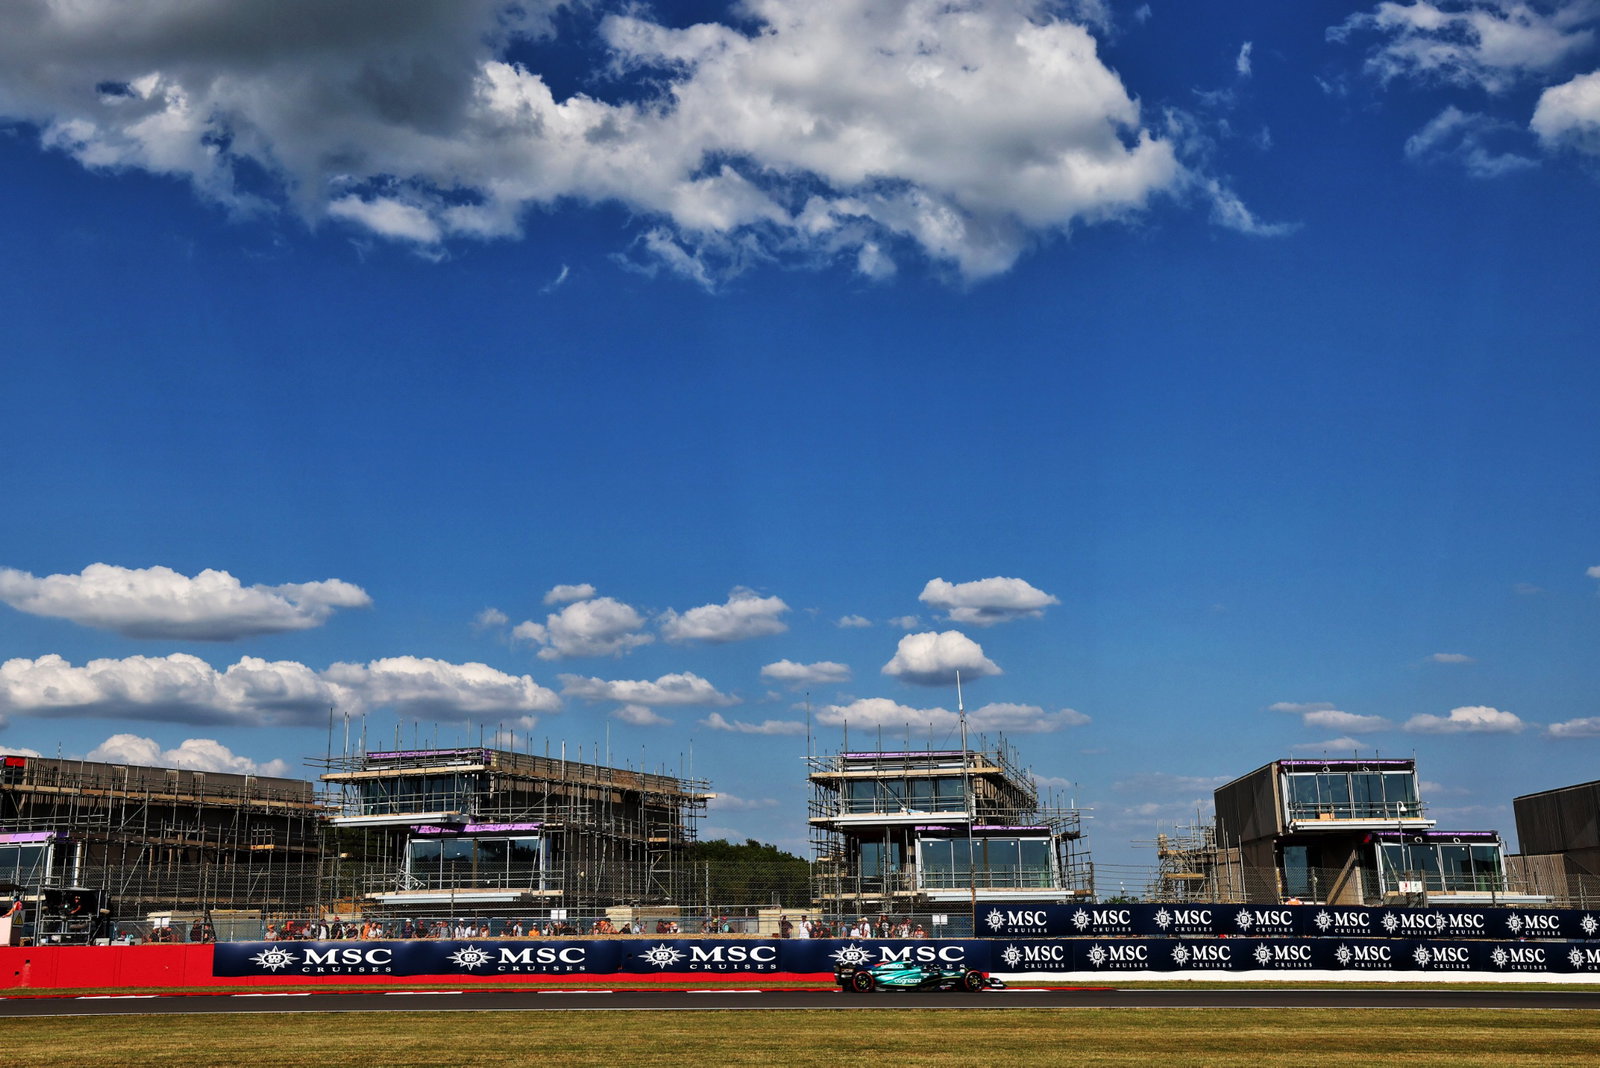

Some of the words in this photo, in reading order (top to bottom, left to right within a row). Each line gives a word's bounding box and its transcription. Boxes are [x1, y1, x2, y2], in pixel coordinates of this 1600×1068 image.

[1007, 911, 1047, 926] MSC
[1092, 910, 1130, 924] MSC
[1174, 910, 1212, 924] MSC
[1255, 911, 1292, 925] MSC
[1334, 912, 1370, 926] MSC
[1401, 914, 1436, 928] MSC
[1449, 914, 1484, 928] MSC
[1525, 915, 1560, 929] MSC
[302, 948, 392, 964] MSC
[498, 948, 586, 964] MSC
[690, 946, 776, 962] MSC
[878, 946, 964, 962] MSC
[1024, 946, 1064, 961] MSC
[1108, 946, 1148, 960] MSC
[1192, 946, 1230, 960] MSC
[1274, 946, 1312, 960] MSC
[1354, 946, 1391, 960] MSC
[1432, 948, 1469, 962] MSC
[1510, 948, 1546, 962] MSC
